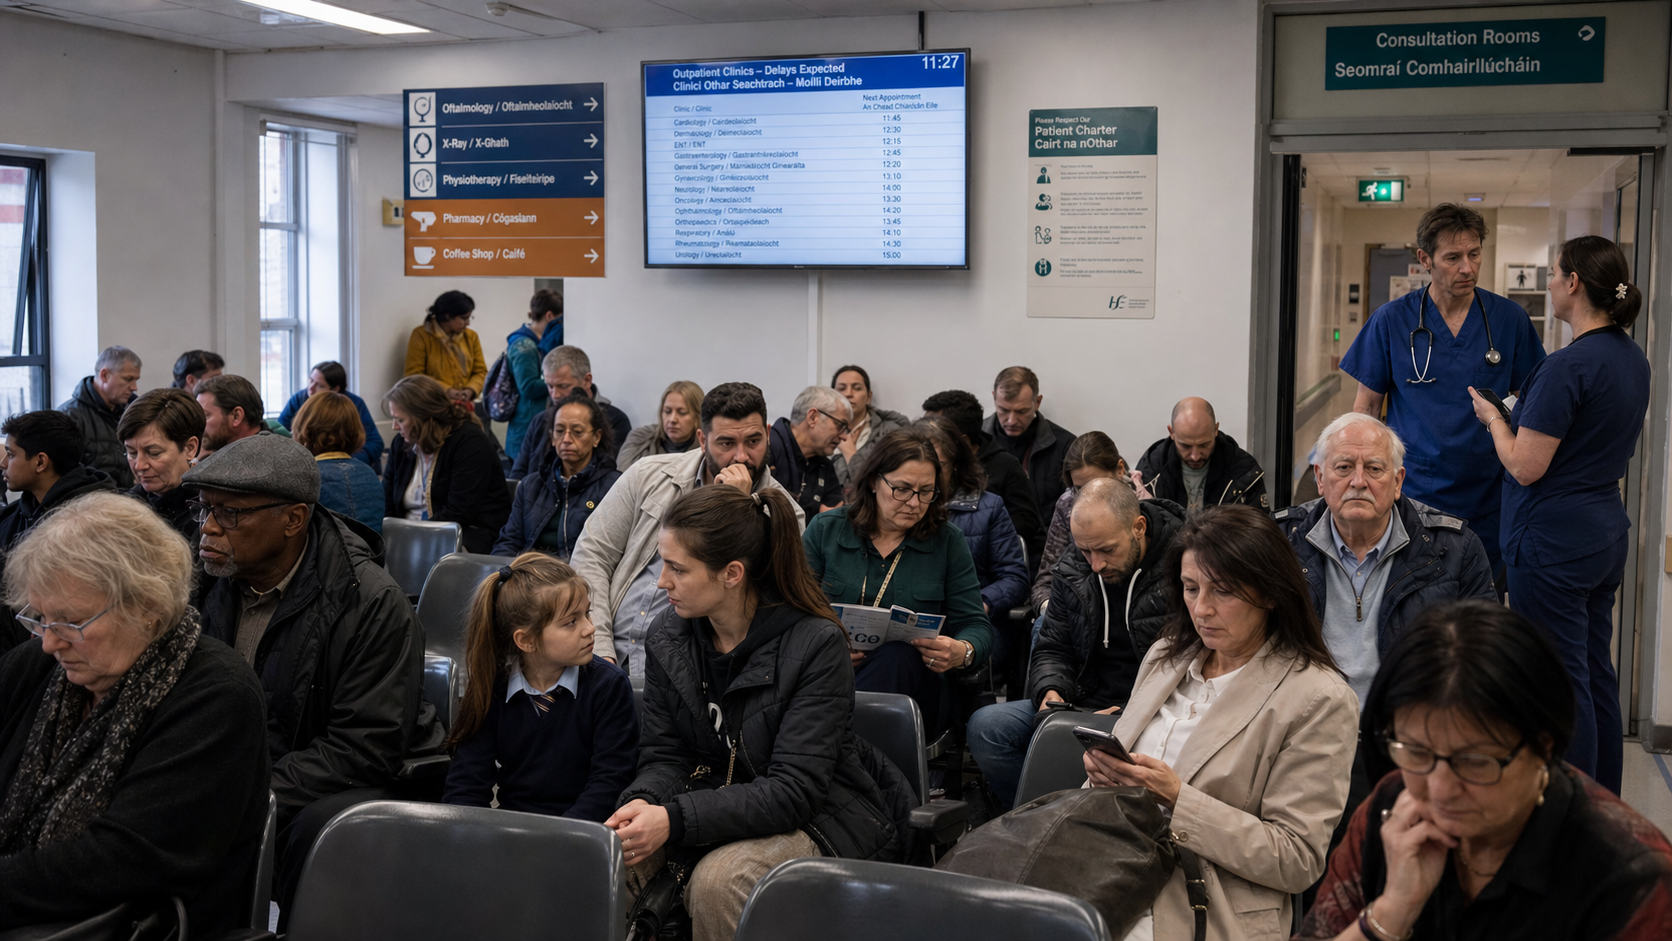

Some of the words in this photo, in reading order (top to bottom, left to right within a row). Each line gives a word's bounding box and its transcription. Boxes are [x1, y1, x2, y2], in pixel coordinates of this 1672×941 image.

[1376, 31, 1477, 48] Consultation
[1483, 29, 1540, 44] Rooms
[922, 56, 959, 70] 11:27
[1335, 61, 1401, 77] Seomraí
[1407, 57, 1540, 75] Comhairllúcháin
[673, 68, 720, 79] Outpatient
[723, 66, 754, 76] Clinics
[765, 65, 797, 76] Delays
[799, 63, 844, 76] Expected
[704, 80, 730, 90] Othar
[732, 78, 785, 89] Seachtrach
[1035, 126, 1073, 136] Patient
[1076, 125, 1117, 135] Charter
[442, 139, 467, 150] X-Ray
[475, 137, 509, 148] X-Ghath
[1035, 139, 1061, 149] Cairt
[1064, 140, 1076, 148] na
[1080, 138, 1118, 148] nOthar
[443, 174, 501, 187] Physiotherapy
[443, 214, 485, 225] Pharmacy
[443, 249, 470, 259] Coffee
[472, 249, 494, 260] Shop
